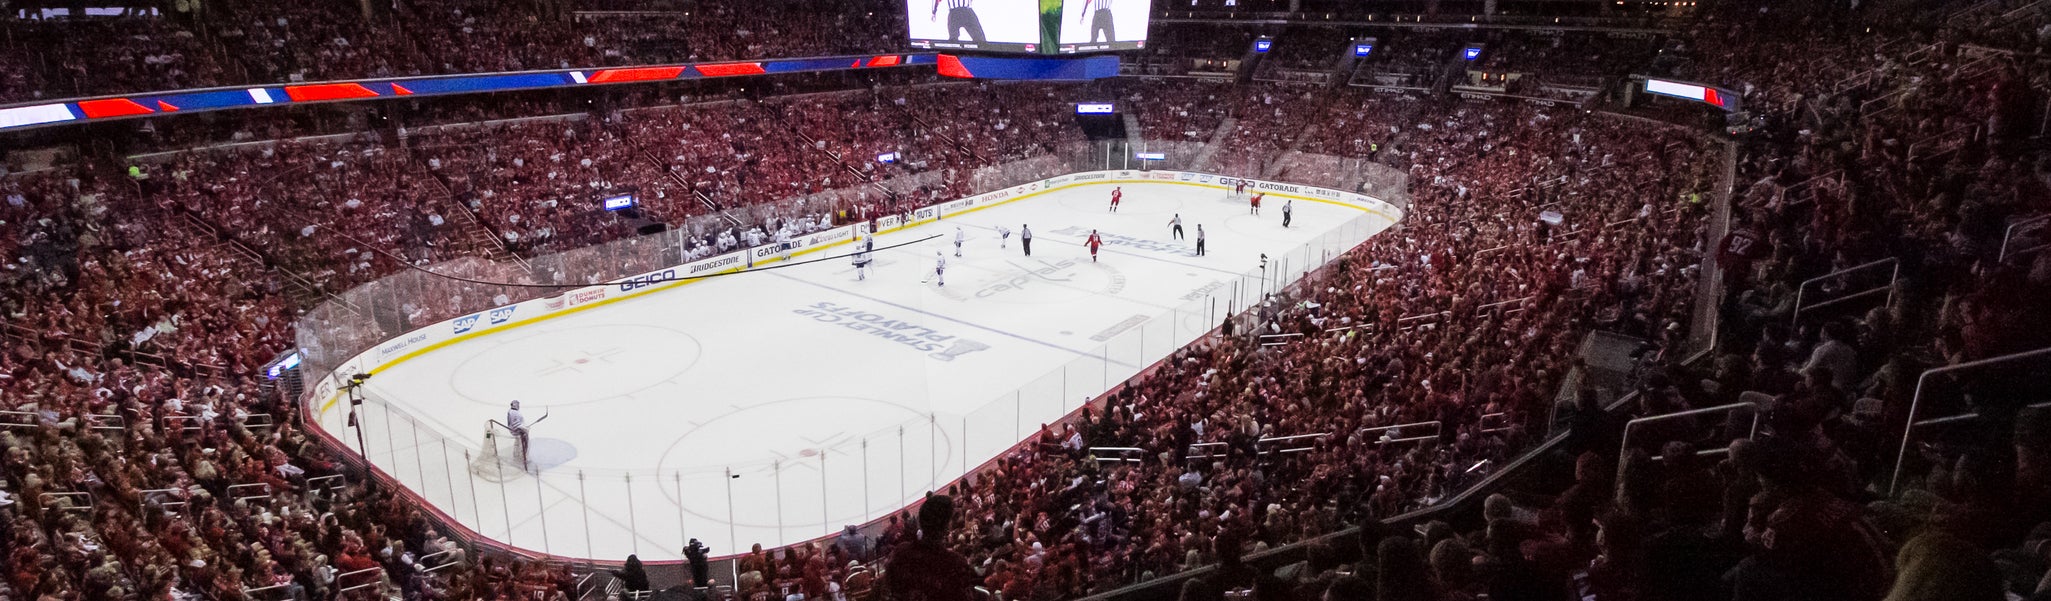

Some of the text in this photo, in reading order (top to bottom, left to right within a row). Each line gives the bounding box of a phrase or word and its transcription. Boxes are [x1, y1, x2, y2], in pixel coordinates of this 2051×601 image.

[982, 191, 1009, 202] HONDA
[1259, 182, 1299, 193] GATORADE
[1728, 235, 1753, 255] 92
[690, 255, 740, 274] BRIDGESTONE
[620, 269, 676, 292] GEICO
[809, 301, 956, 342] PLAYOFFS
[837, 321, 945, 352] STANLEY
